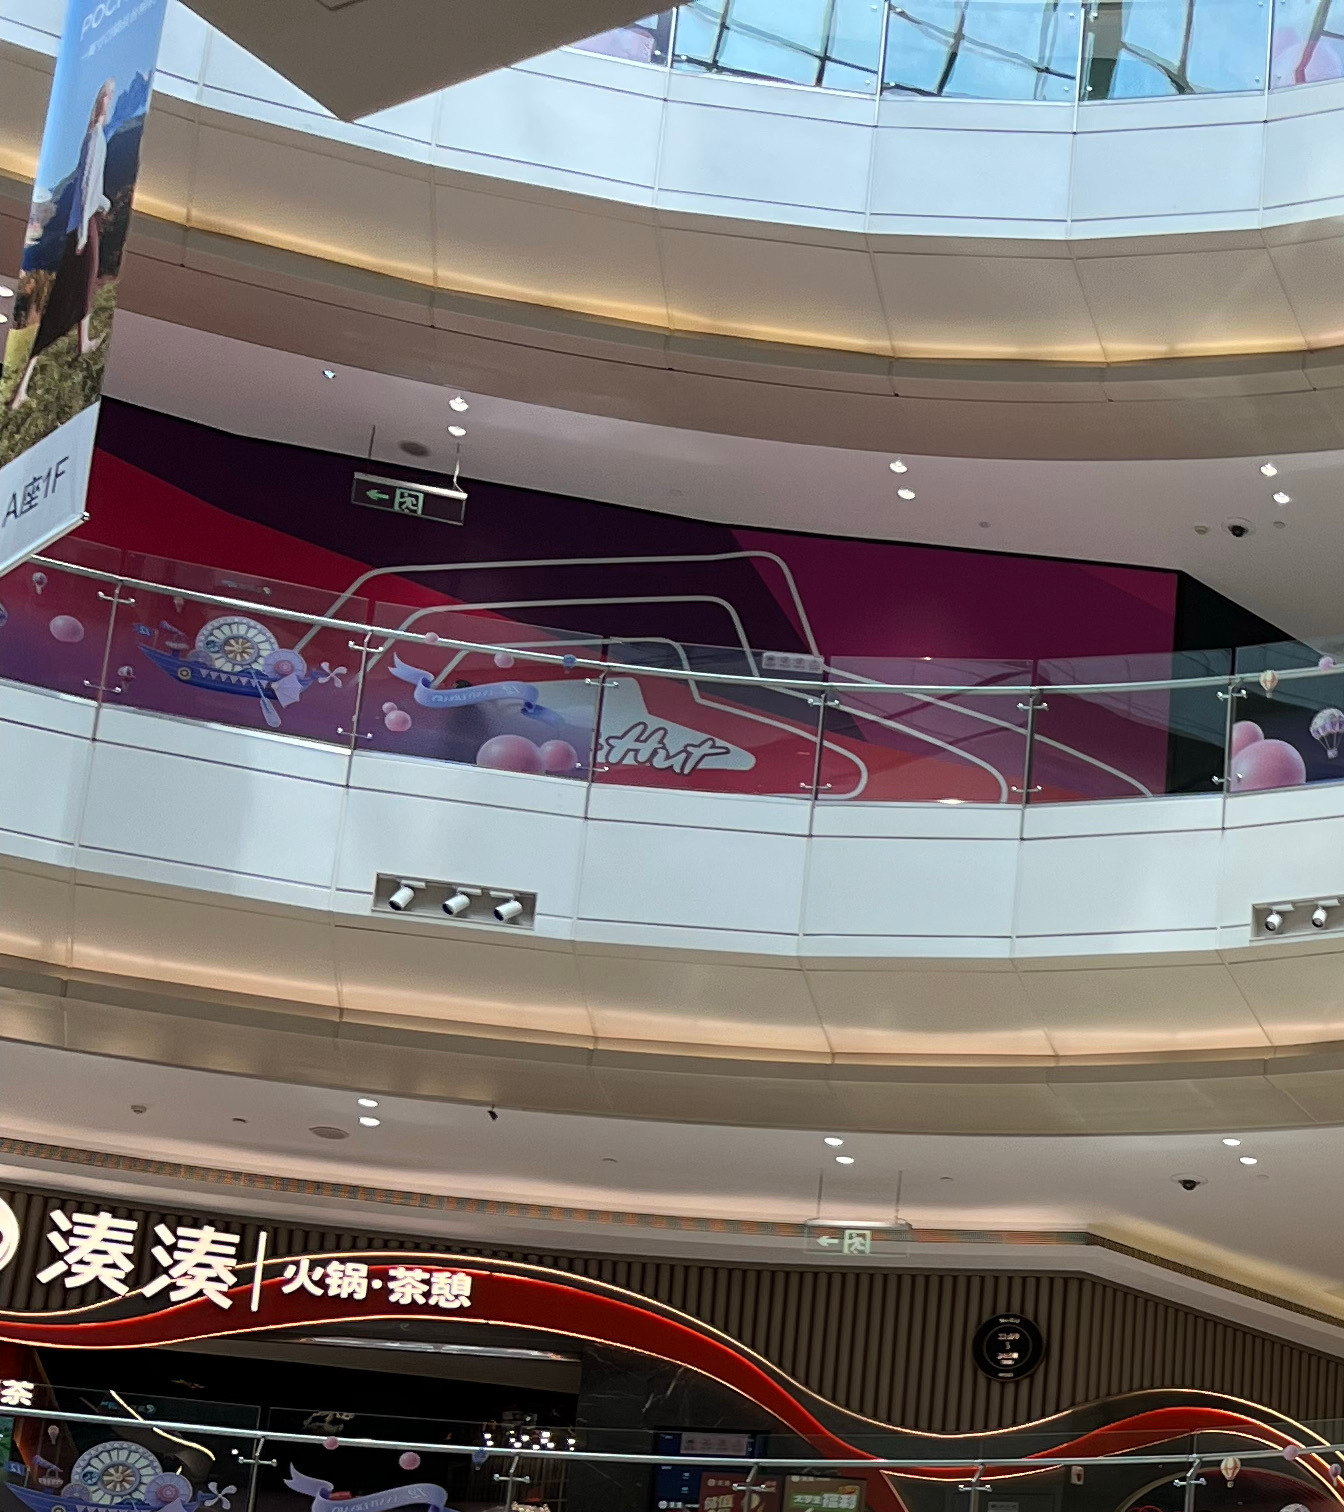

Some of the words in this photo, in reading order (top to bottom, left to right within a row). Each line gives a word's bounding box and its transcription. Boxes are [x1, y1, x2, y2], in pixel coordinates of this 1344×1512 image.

[80, 0, 121, 41] POC
[2, 456, 69, 528] A座1F
[605, 721, 730, 775] Hut
[281, 1257, 472, 1310] 火锅·茶憩
